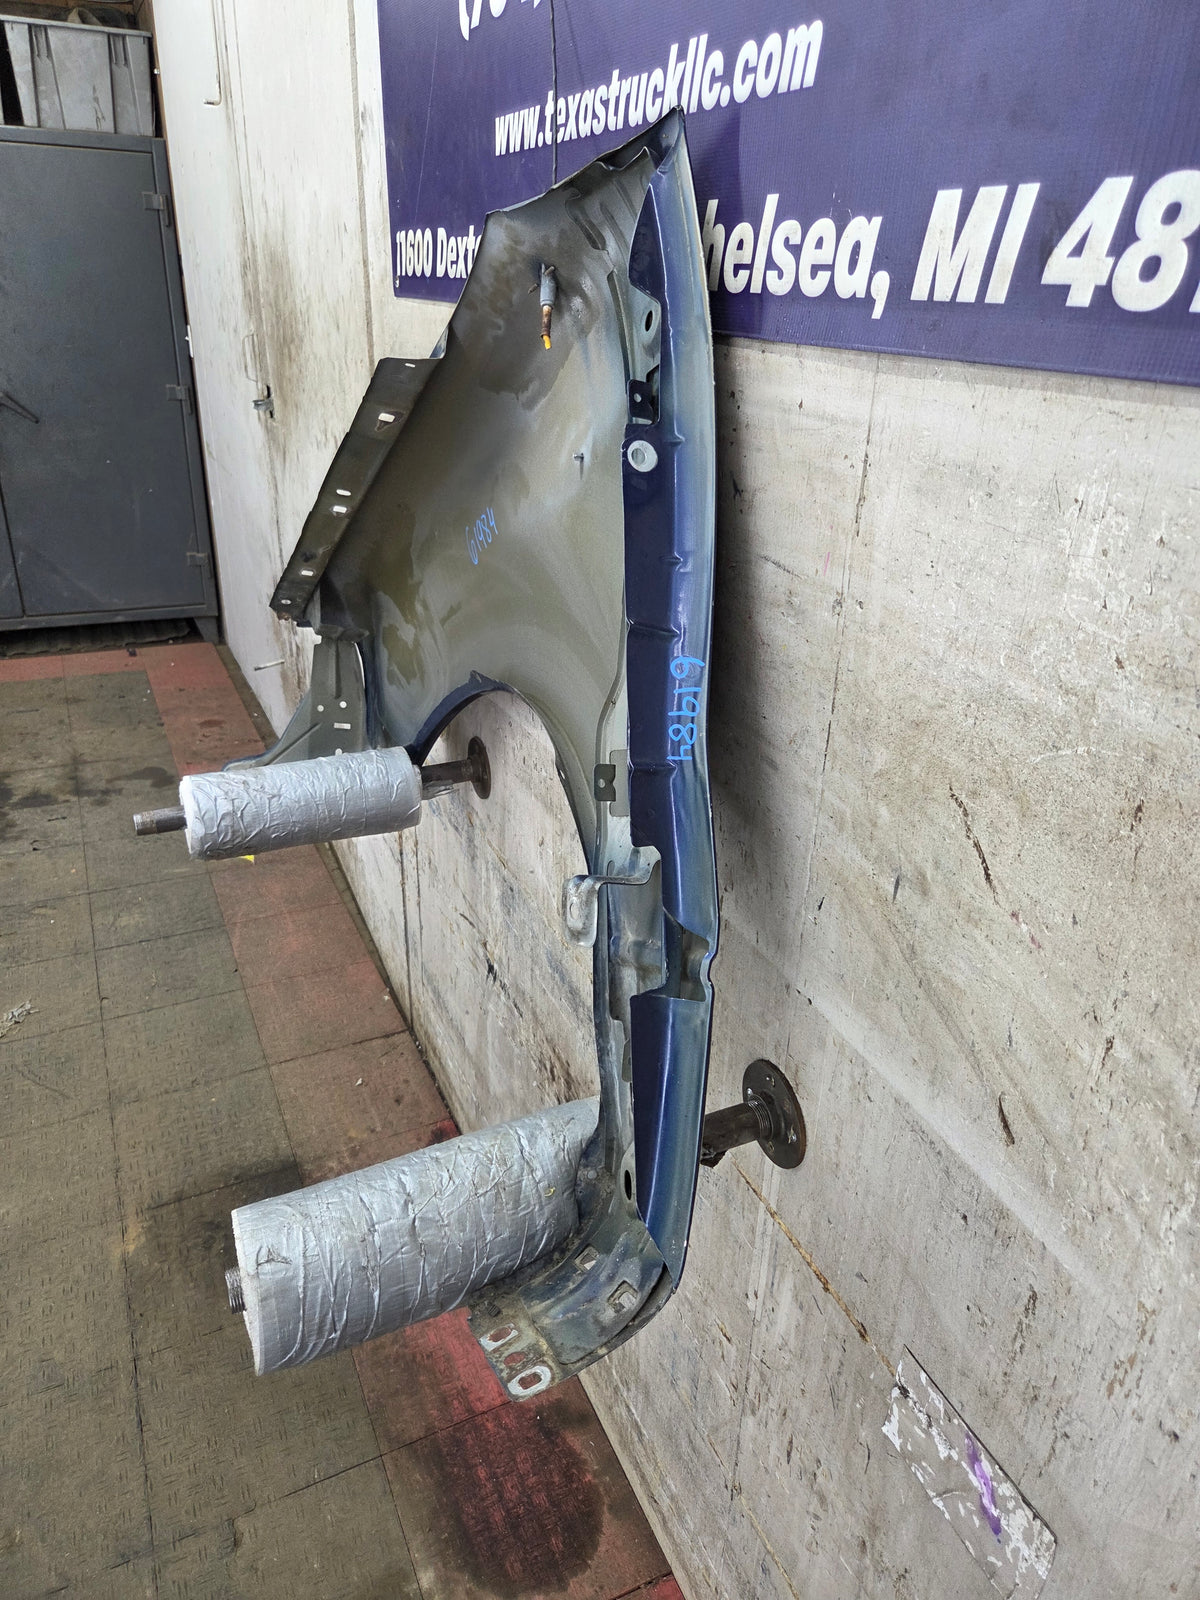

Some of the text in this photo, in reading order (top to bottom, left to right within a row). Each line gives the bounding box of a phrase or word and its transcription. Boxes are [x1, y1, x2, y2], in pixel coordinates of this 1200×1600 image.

[495, 20, 823, 156] www.texastruckllc.com
[396, 169, 1200, 319] 11600 Dext helsea, MI 48
[465, 506, 499, 565] 61984
[666, 655, 706, 761] 61984
